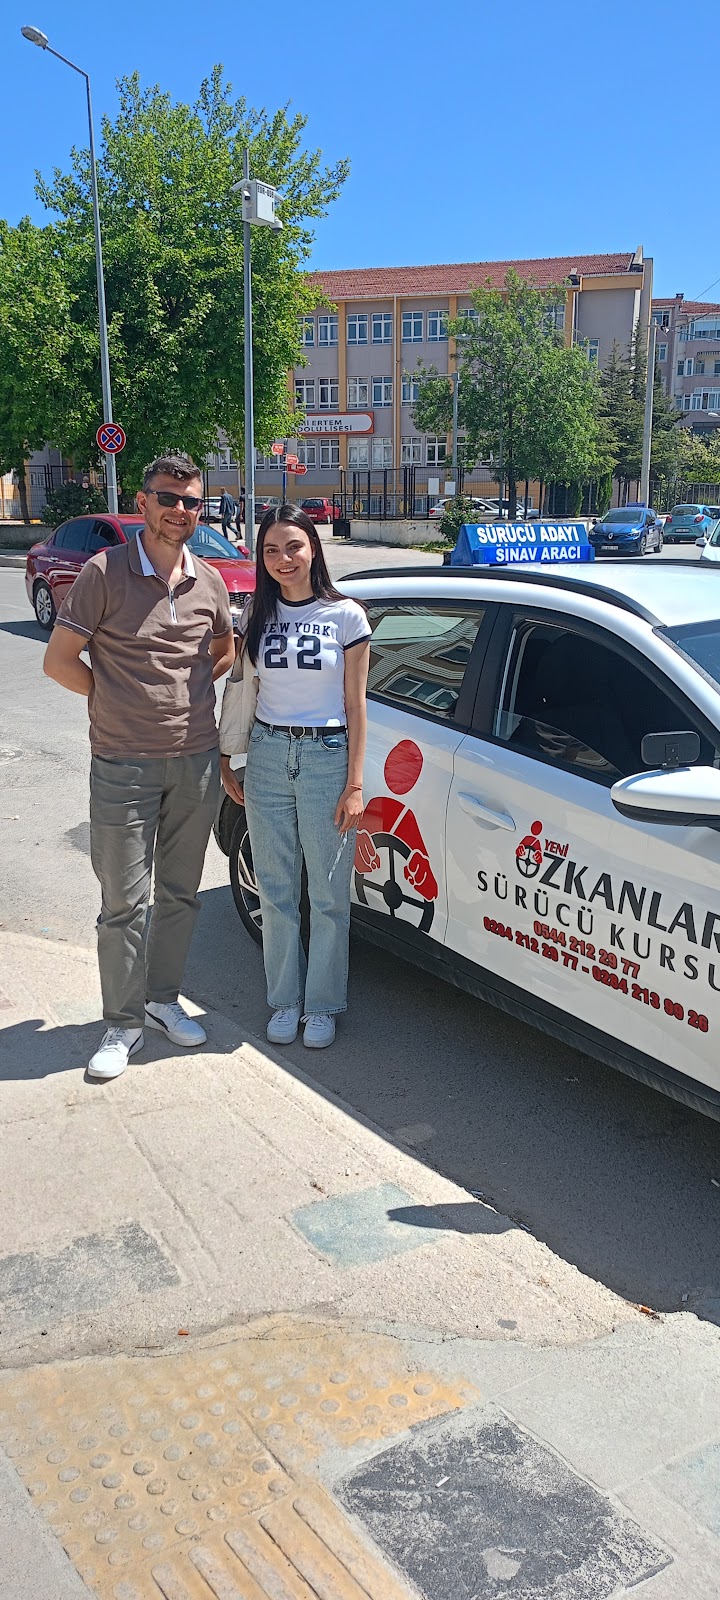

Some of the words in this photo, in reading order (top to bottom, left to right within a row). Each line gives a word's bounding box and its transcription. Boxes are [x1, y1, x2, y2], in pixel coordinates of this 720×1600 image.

[477, 523, 536, 544] SÜRÜCÜ
[540, 526, 580, 542] ADAYI
[541, 546, 581, 560] ARACI
[295, 622, 331, 636] YORK
[265, 634, 322, 670] 22
[545, 839, 569, 857] YENİ
[477, 870, 594, 935] SÜRÜCÜ
[610, 923, 720, 992] KURSU
[533, 920, 567, 948] 0544
[569, 936, 596, 961] 212
[599, 949, 618, 970] 29
[621, 957, 641, 979] 77
[483, 916, 513, 941] 0284
[515, 931, 539, 954] 212
[542, 943, 559, 962] 29
[561, 951, 581, 971] 77
[592, 965, 629, 995] 0284
[631, 983, 661, 1010] 213
[687, 1010, 709, 1033] 26
